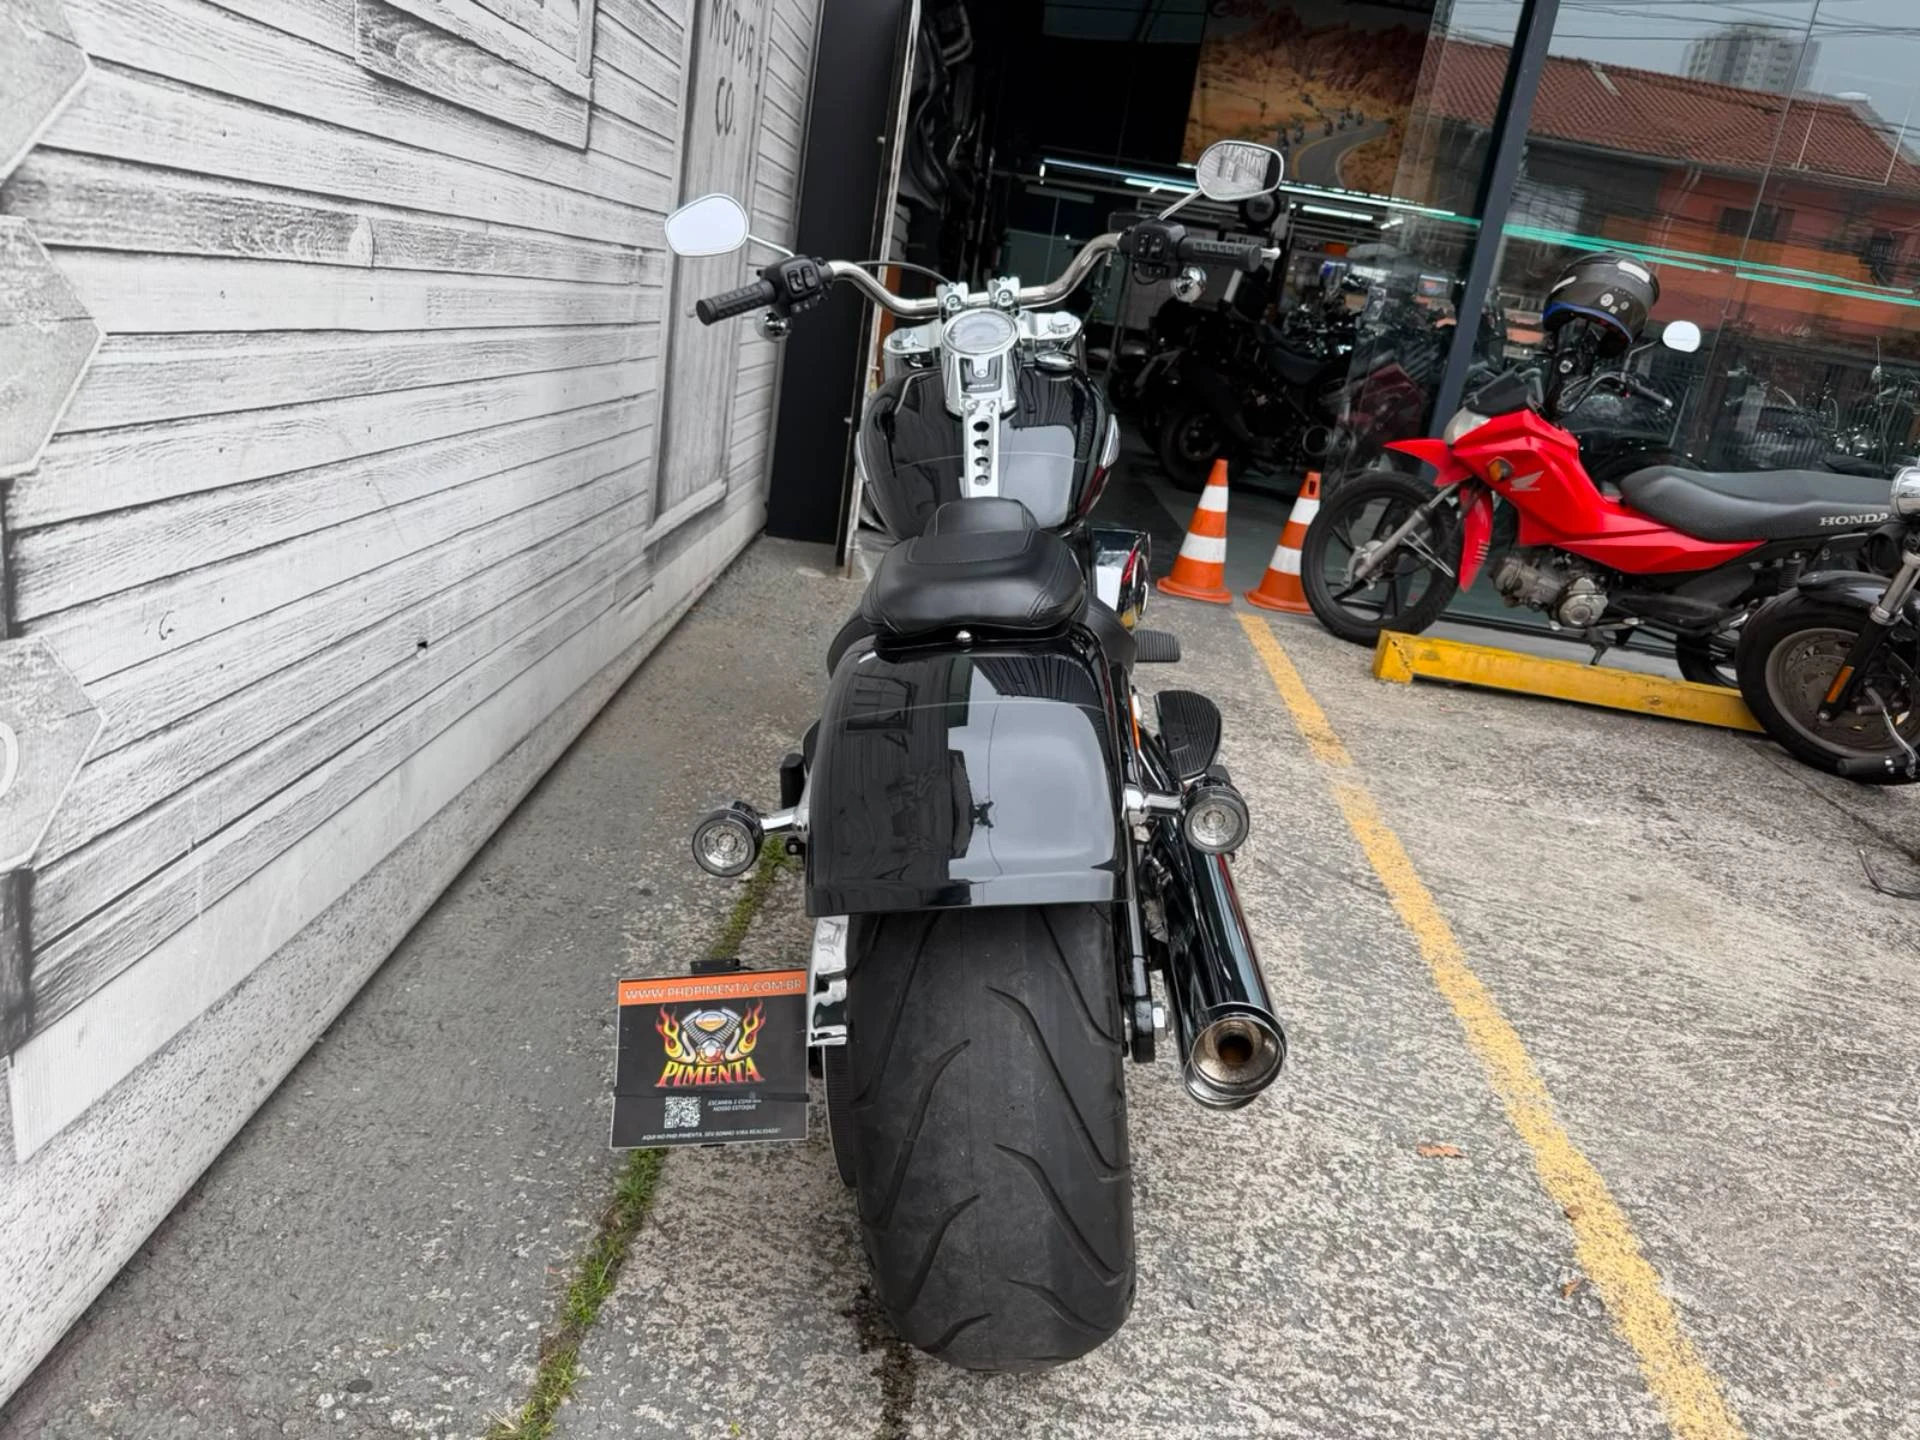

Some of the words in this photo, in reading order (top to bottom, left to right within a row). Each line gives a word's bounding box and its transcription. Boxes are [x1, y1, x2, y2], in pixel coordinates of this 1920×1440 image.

[709, 0, 755, 78] MOTOR
[1819, 512, 1889, 526] HONDA
[624, 979, 802, 1000] WWW.PHDPIMENTA.COM.BR
[655, 1057, 766, 1088] PIMENTA
